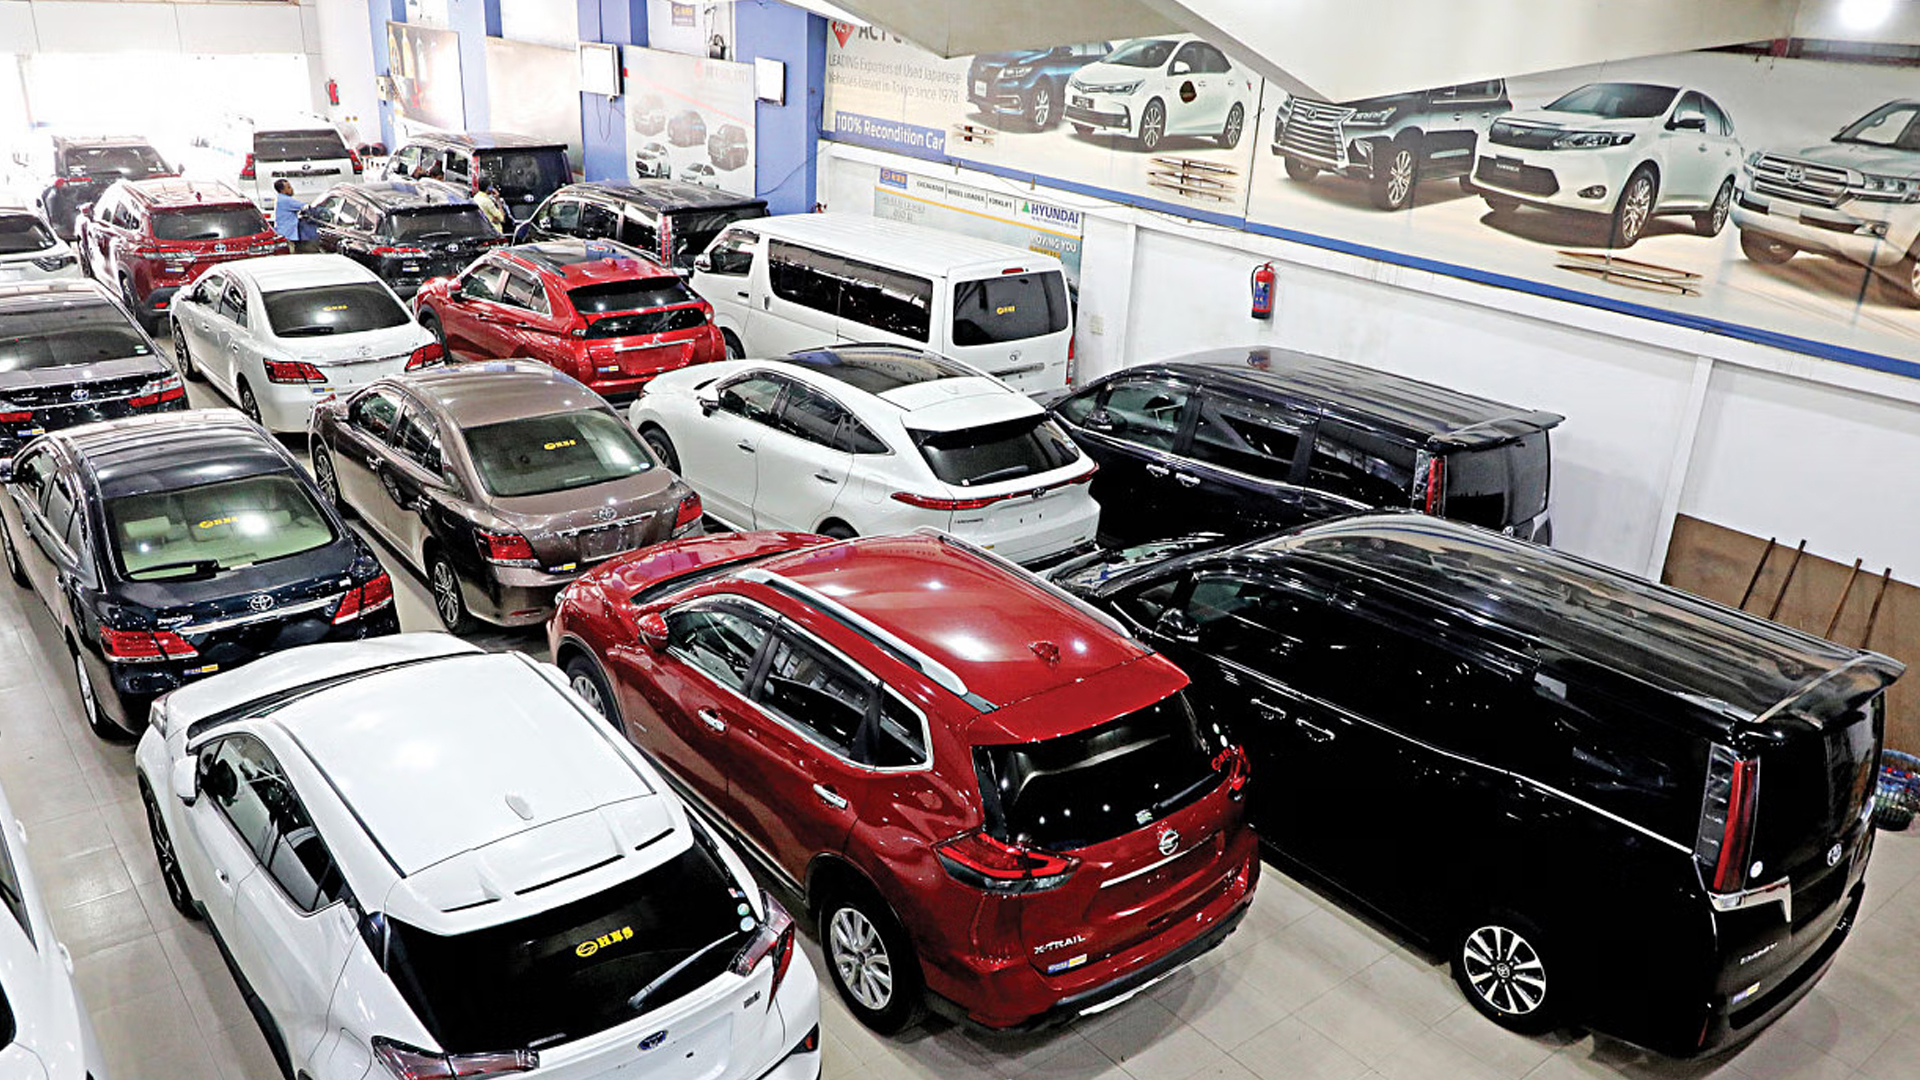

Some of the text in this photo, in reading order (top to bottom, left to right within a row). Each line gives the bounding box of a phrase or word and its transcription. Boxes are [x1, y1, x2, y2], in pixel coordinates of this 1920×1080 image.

[828, 54, 961, 85] LEADING Exporters of Used Japanese
[828, 72, 858, 87] Vehicles
[858, 76, 882, 91] based
[891, 80, 915, 98] Tokyo
[915, 85, 937, 100] since
[938, 89, 959, 104] 1978
[836, 114, 945, 151] 100% Recondition Car
[916, 181, 944, 193] EXCAVATOR
[963, 191, 985, 202] LOADER
[988, 197, 1013, 209] FORKLIFT
[1031, 203, 1080, 224] HYUNDAI
[1061, 239, 1077, 253] YOU
[1034, 934, 1087, 955] X-TRAIL
